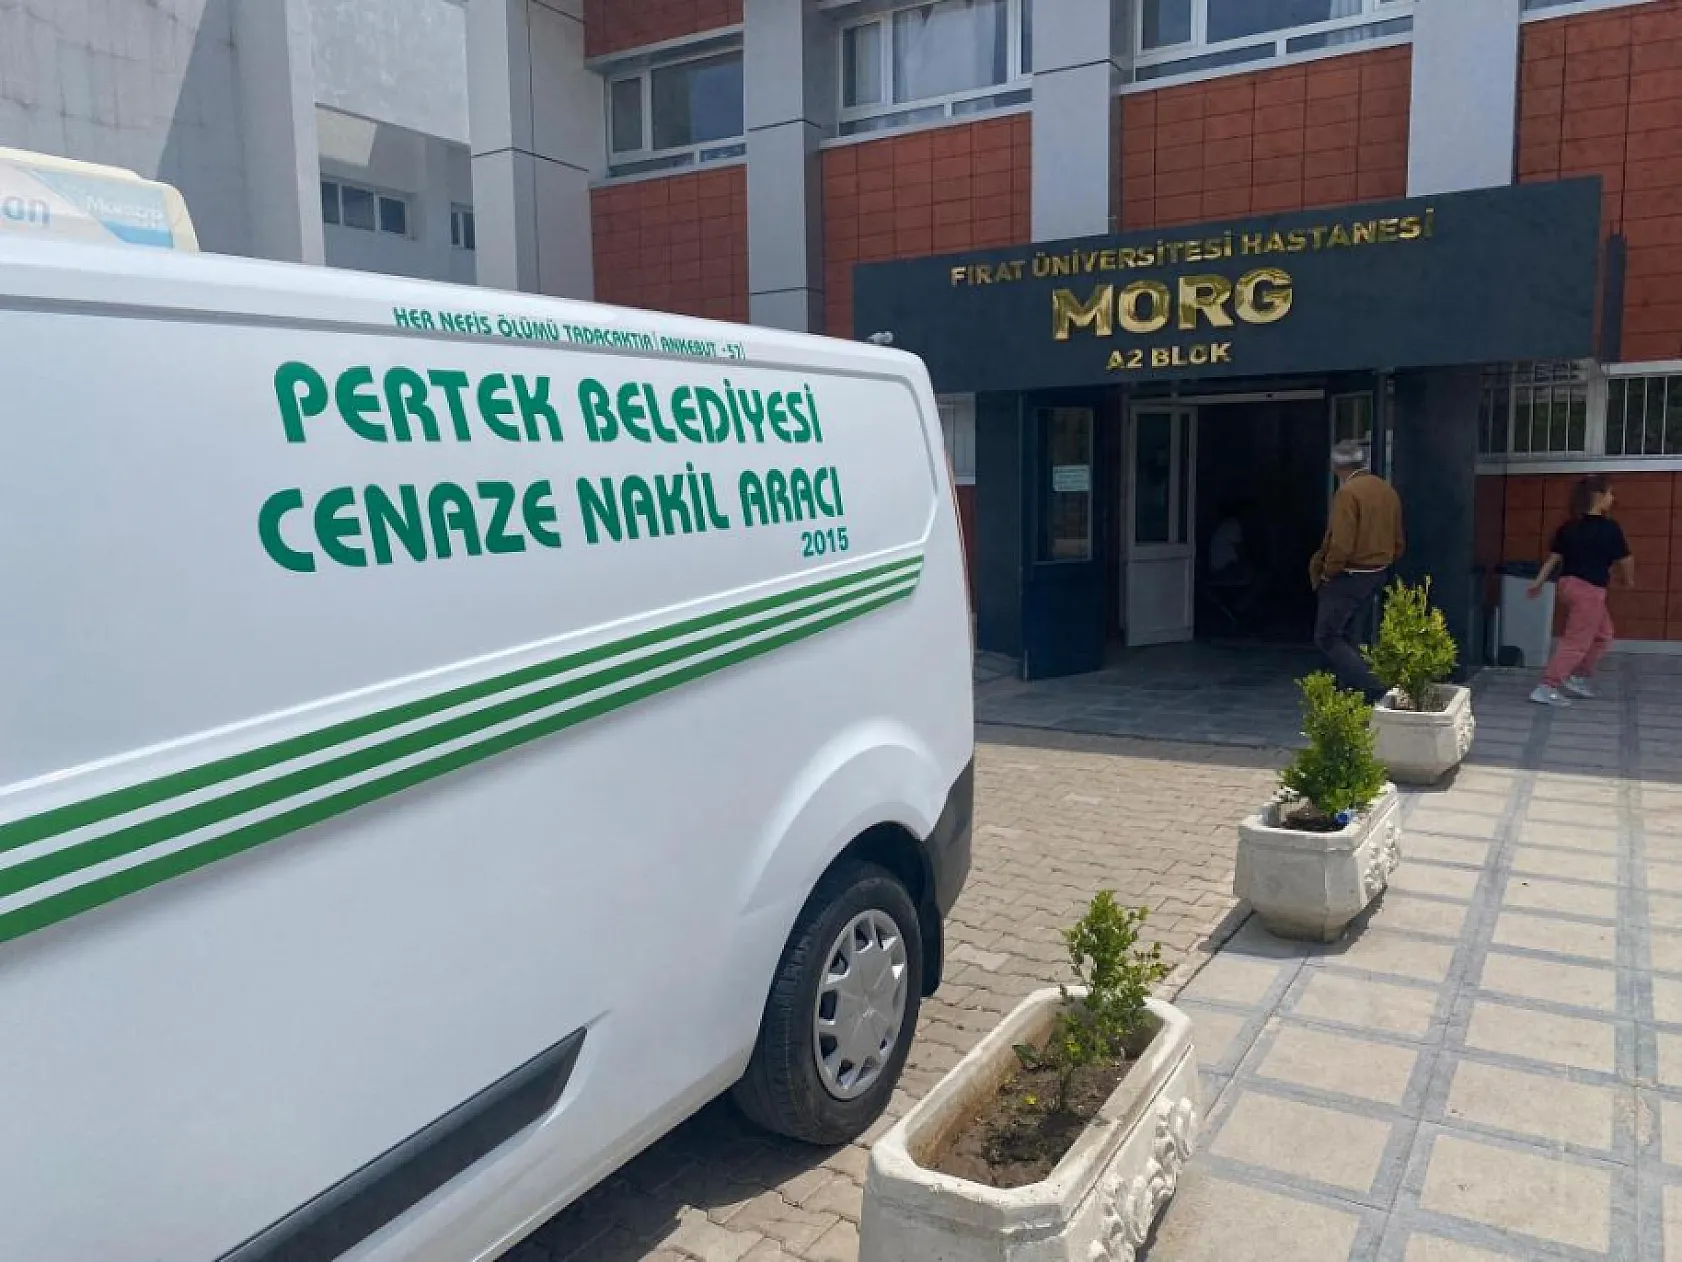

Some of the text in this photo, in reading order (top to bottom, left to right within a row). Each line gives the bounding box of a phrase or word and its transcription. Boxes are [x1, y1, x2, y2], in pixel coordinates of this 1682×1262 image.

[950, 208, 1434, 286] FIRAT ÜNİVERSİTESİ HASTANESİ
[393, 307, 434, 331] HER
[438, 310, 492, 335] NEFİS
[497, 314, 560, 341] ÖLÜMÜ
[1052, 267, 1293, 341] MORG
[1107, 341, 1231, 370] A2 BLOK
[274, 361, 823, 443] PERTEK BELEDİYESİ
[258, 460, 845, 572] CENAZE NAKİL ARACI
[801, 527, 849, 557] 2015
